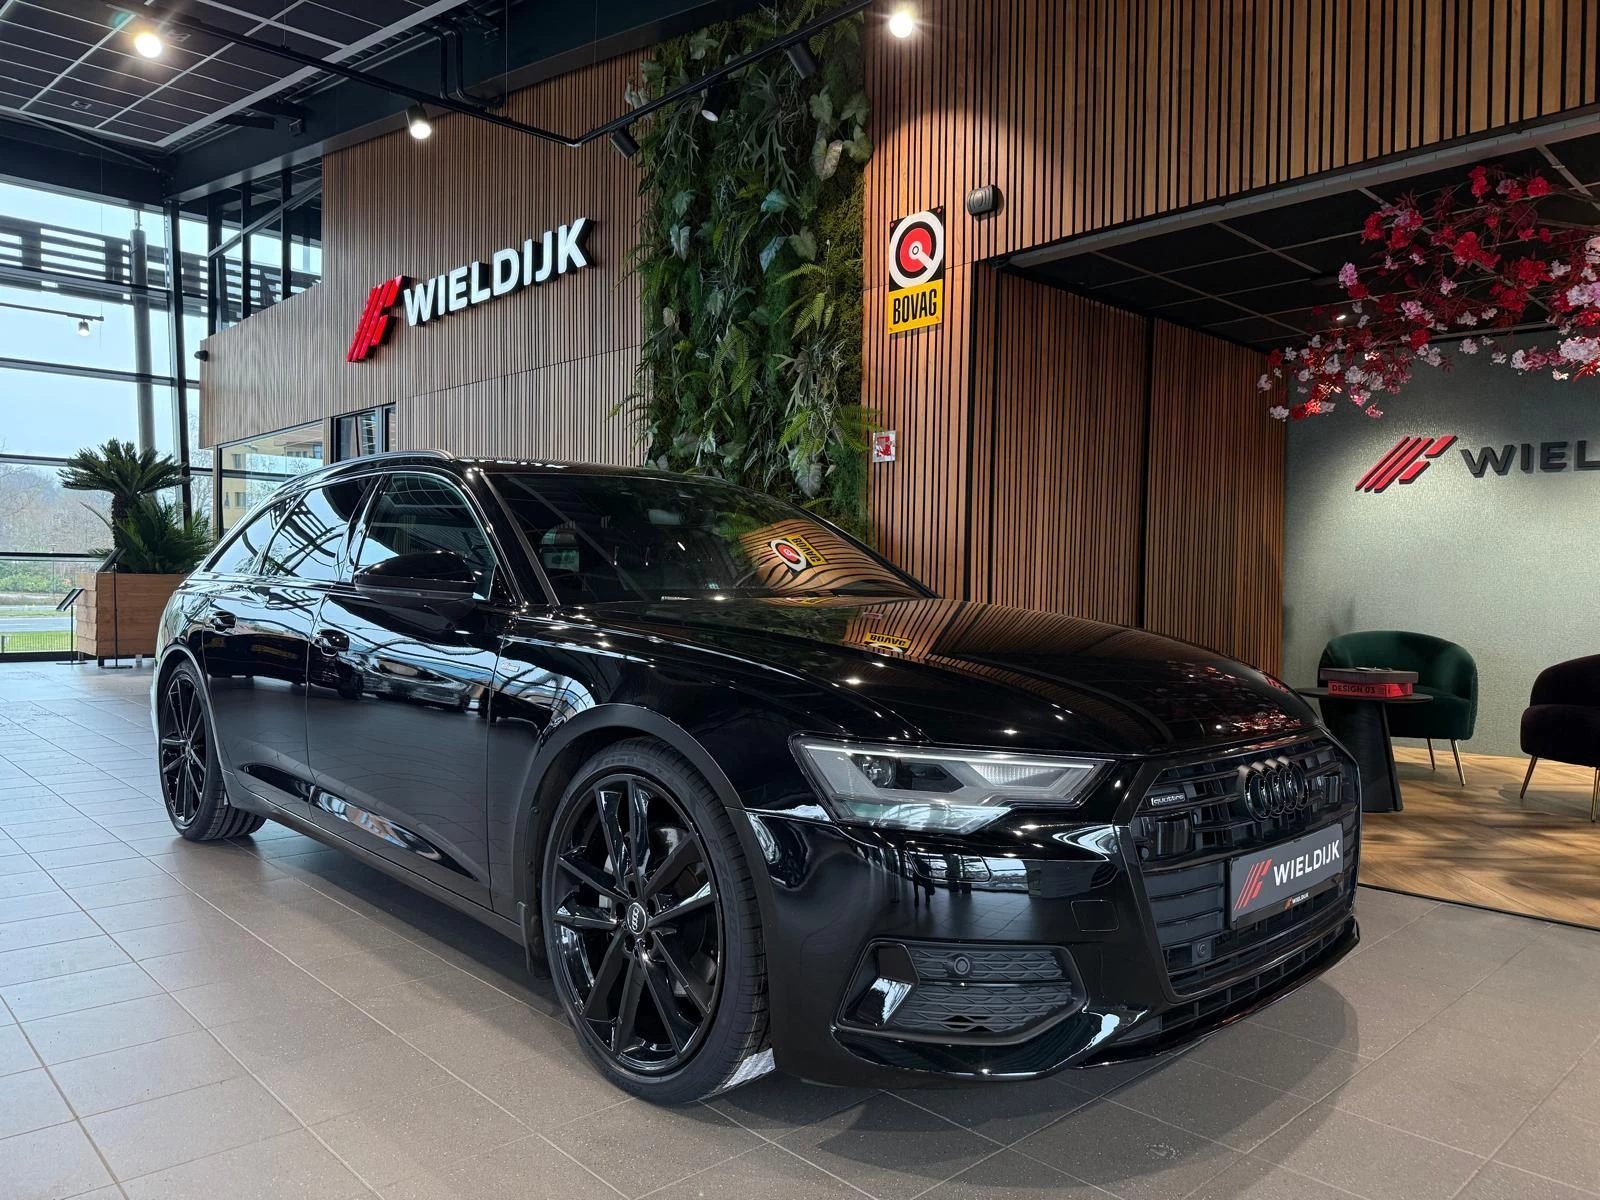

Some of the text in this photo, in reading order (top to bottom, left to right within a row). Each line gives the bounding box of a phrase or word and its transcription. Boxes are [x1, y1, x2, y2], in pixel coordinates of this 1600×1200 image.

[403, 217, 590, 327] WIELDIJK
[893, 288, 937, 325] BOVAG
[1332, 684, 1376, 694] DESIGN 03
[1153, 794, 1184, 805] quattro
[1273, 840, 1340, 886] WIELDIJK
